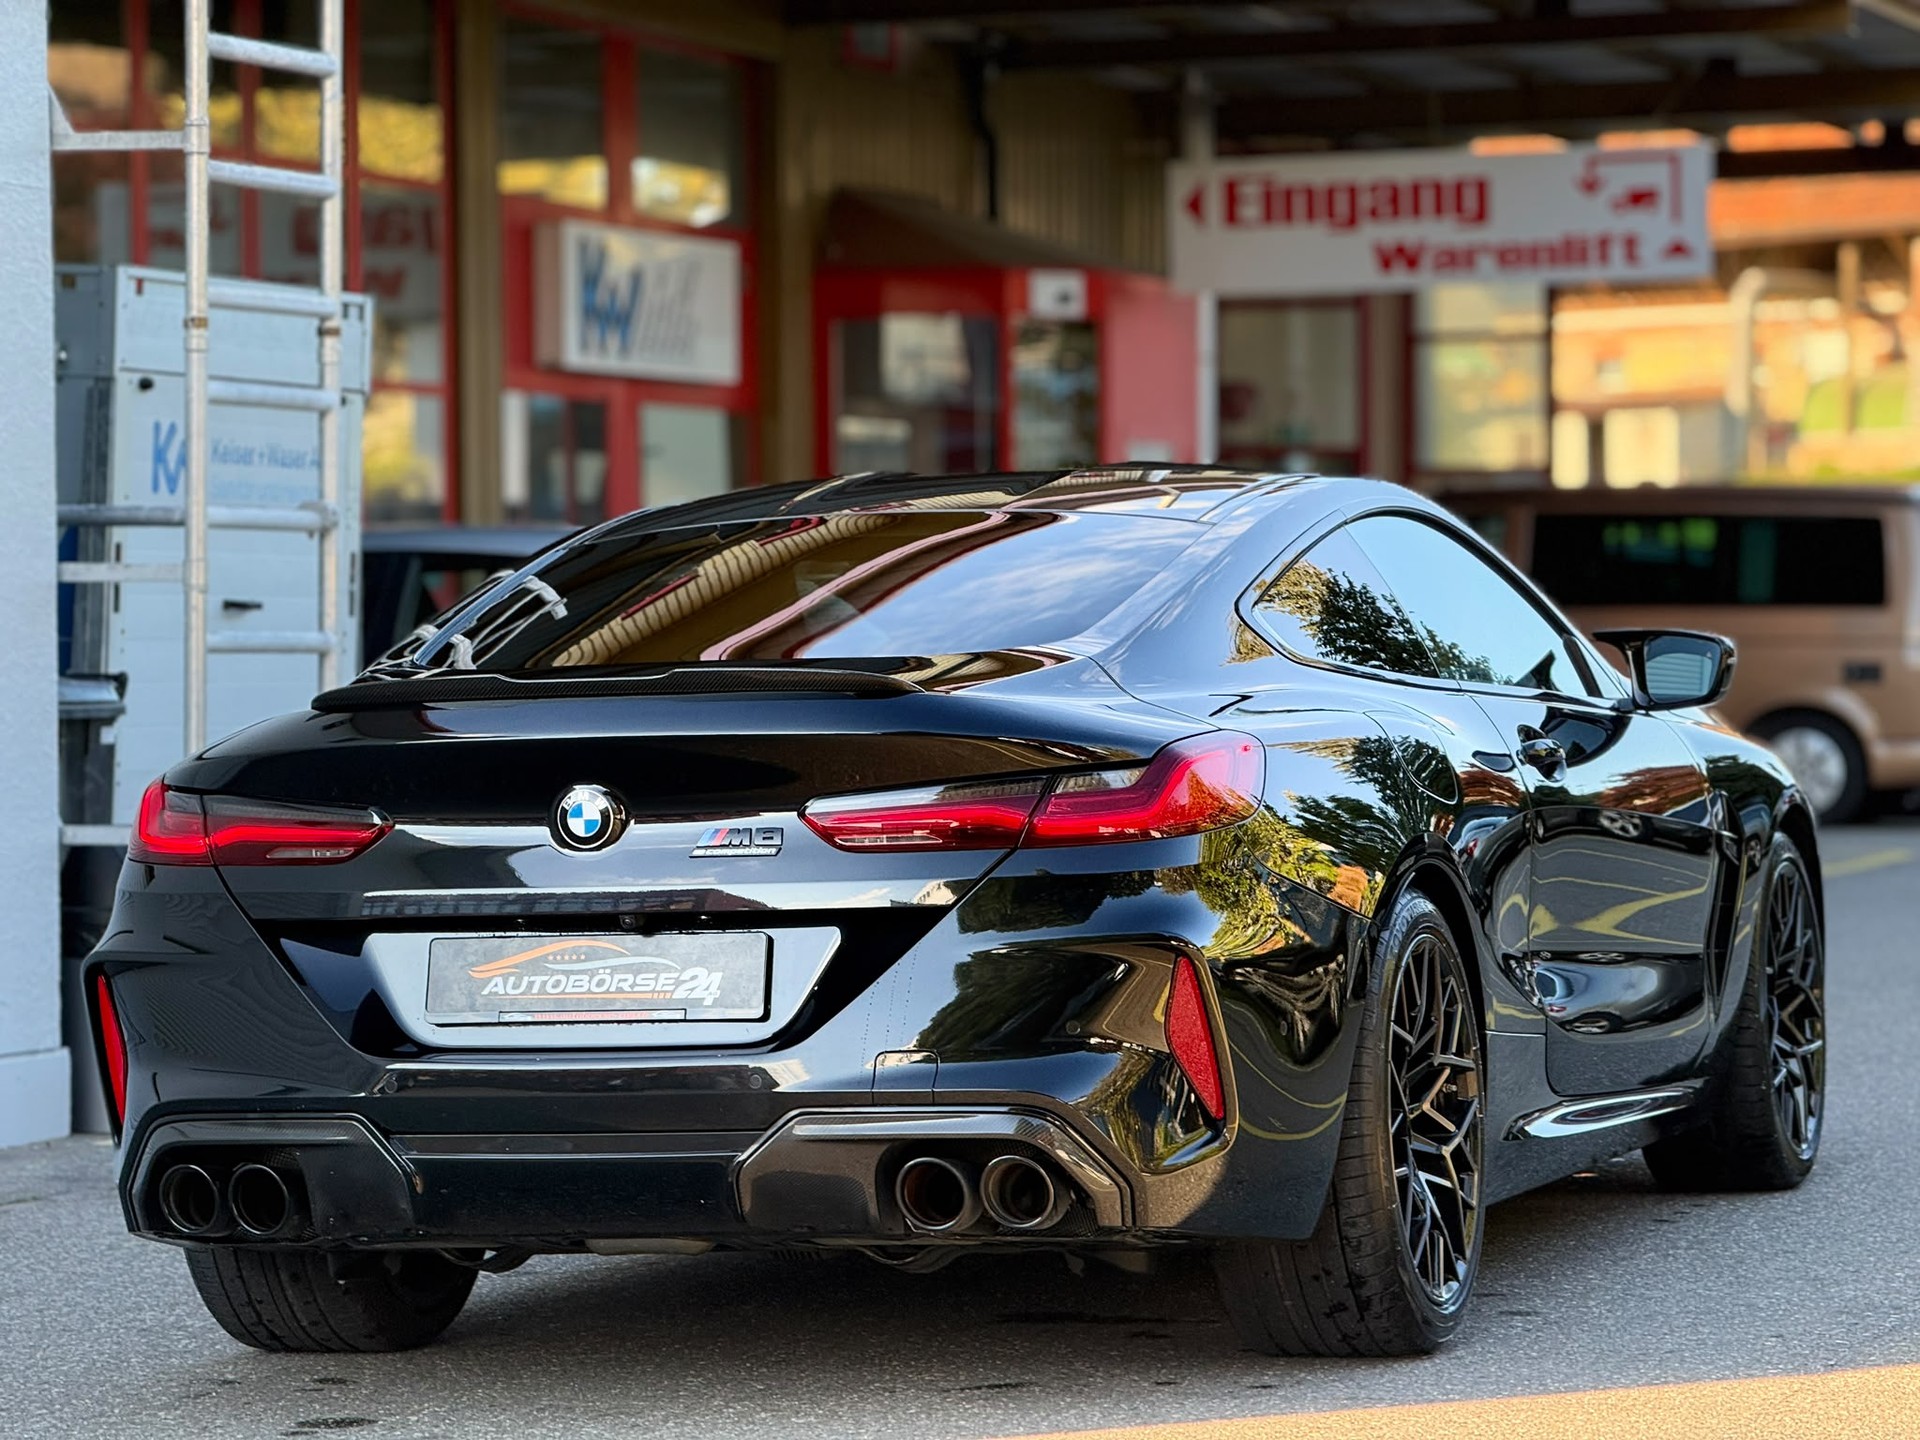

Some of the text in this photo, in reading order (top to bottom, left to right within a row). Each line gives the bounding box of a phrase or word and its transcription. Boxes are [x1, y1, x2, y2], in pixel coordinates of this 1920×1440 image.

[1221, 173, 1489, 231] Eingang
[1374, 234, 1639, 274] Warenlift
[705, 847, 778, 856] competition
